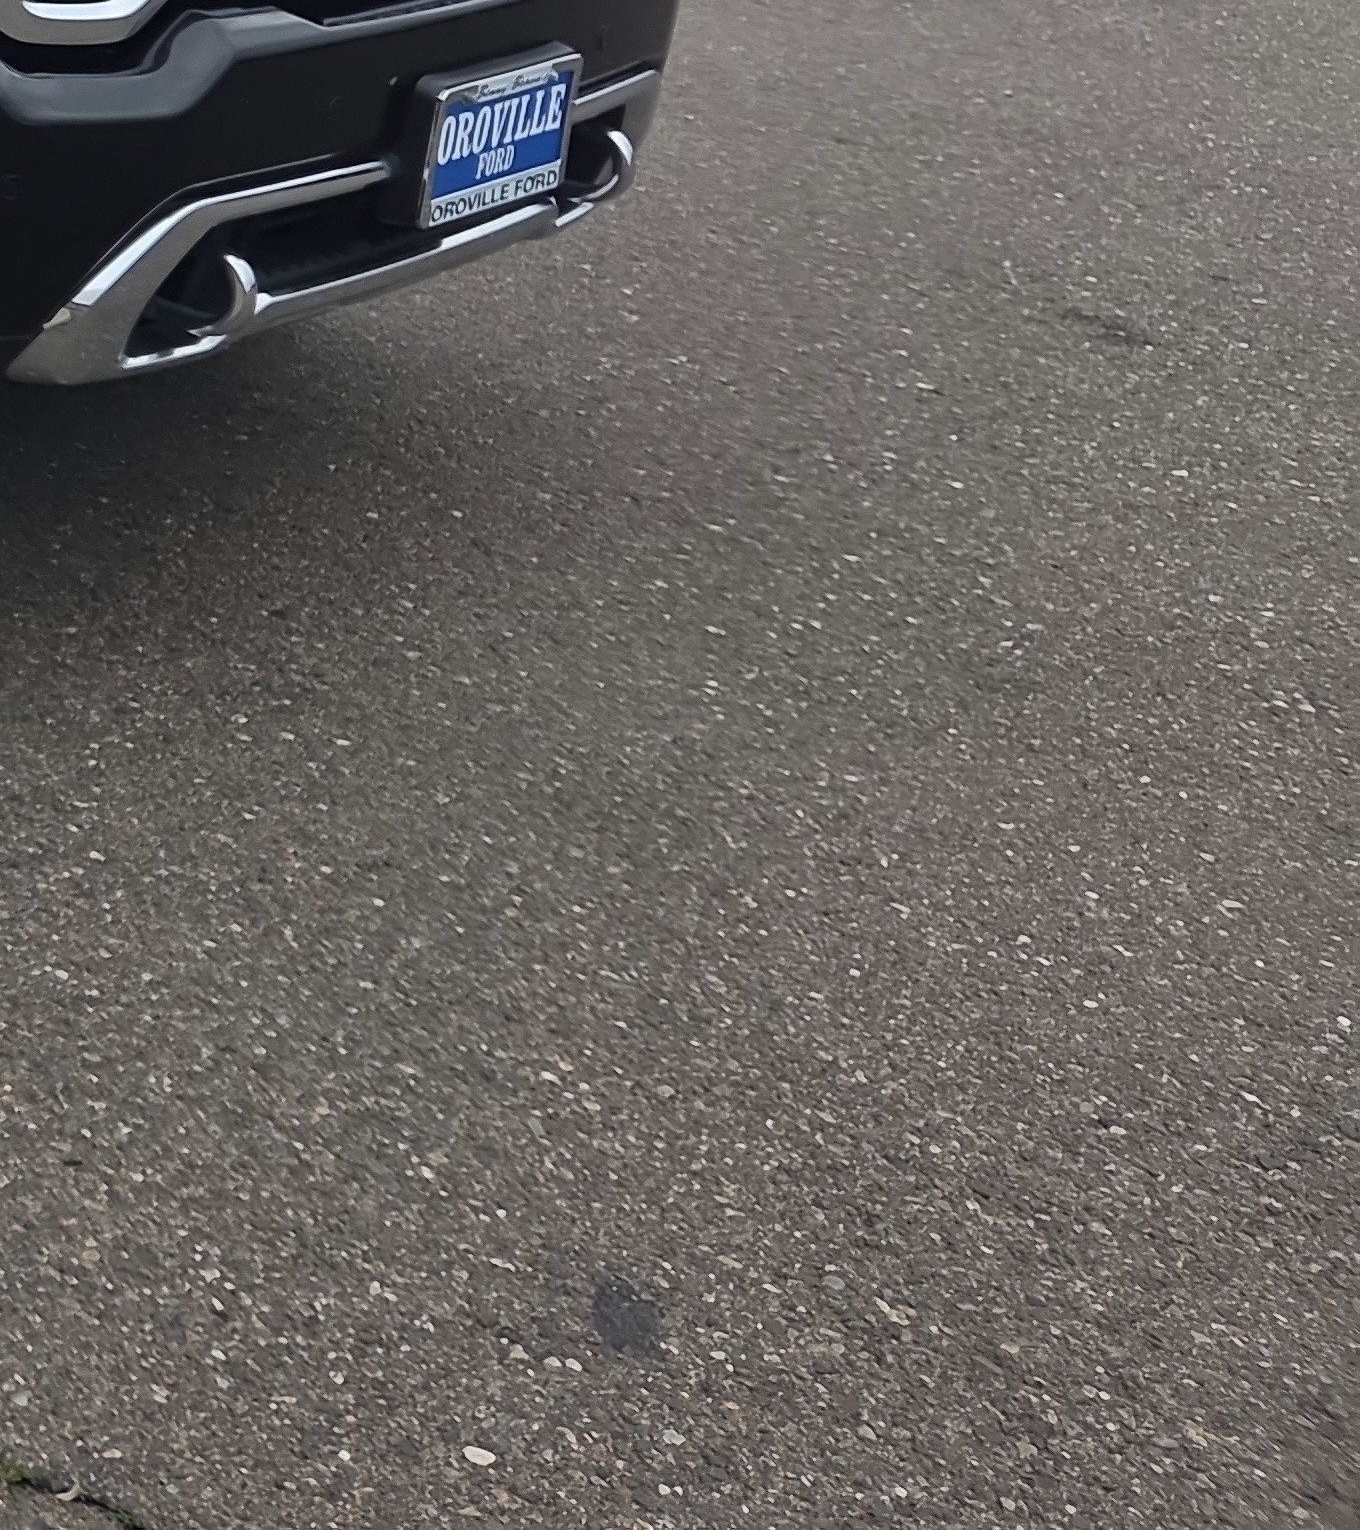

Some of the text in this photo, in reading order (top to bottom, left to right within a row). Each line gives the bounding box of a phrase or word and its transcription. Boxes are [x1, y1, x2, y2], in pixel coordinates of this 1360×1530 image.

[437, 83, 567, 166] OROVILLE
[474, 144, 515, 181] FORD
[431, 169, 557, 223] OROVILLE FORD
